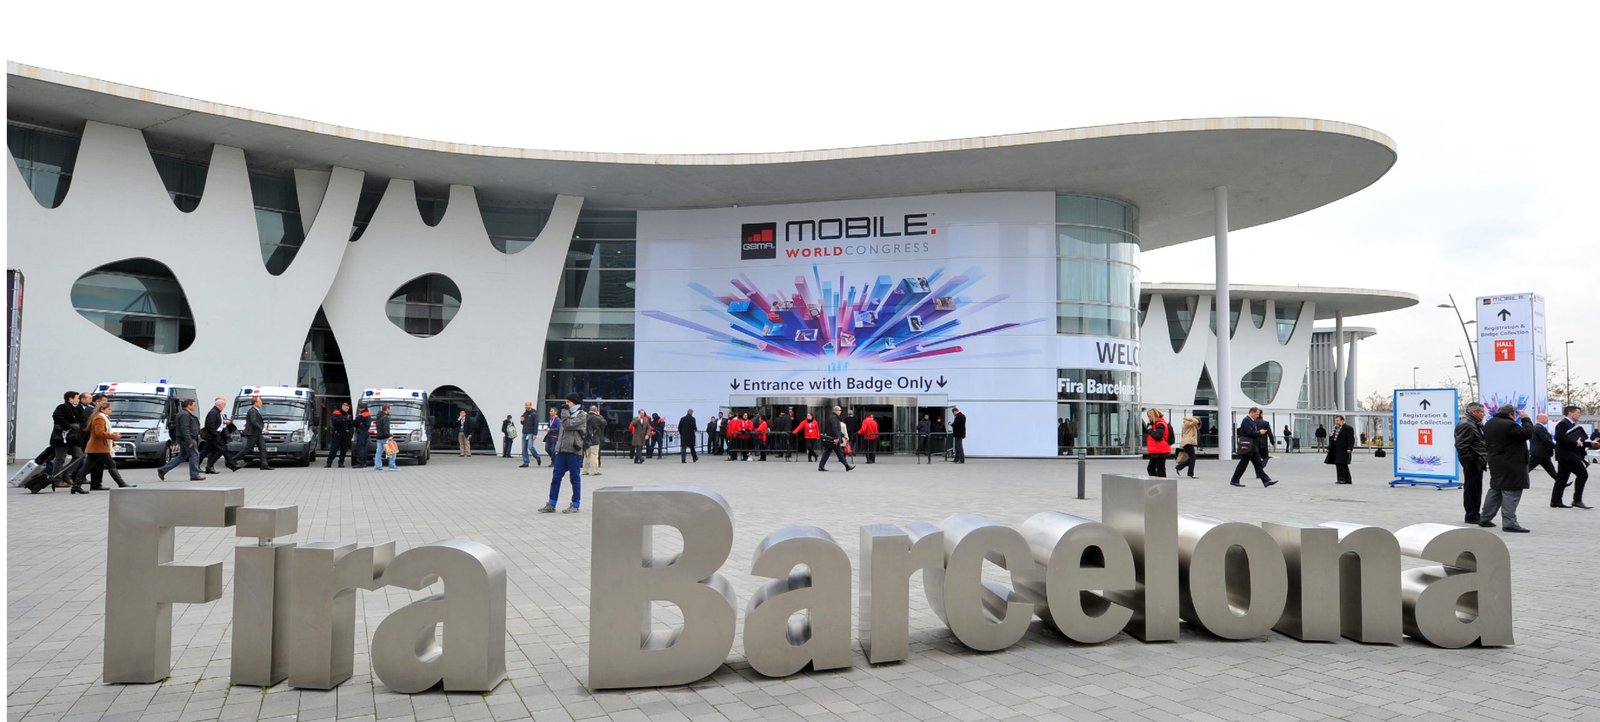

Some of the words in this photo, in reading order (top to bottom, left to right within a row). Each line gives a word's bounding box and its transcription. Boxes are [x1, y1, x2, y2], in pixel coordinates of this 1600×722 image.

[1096, 341, 1141, 367] WELC
[1501, 348, 1509, 360] 1
[743, 378, 804, 391] Entrance
[808, 377, 841, 391] with
[847, 376, 893, 392] Badge
[897, 376, 933, 392] Only
[1057, 377, 1085, 394] Fira
[1087, 379, 1135, 395] Barcelona
[1422, 435, 1428, 444] 1
[103, 487, 507, 694] Fira
[588, 474, 1515, 692] Barcelona
